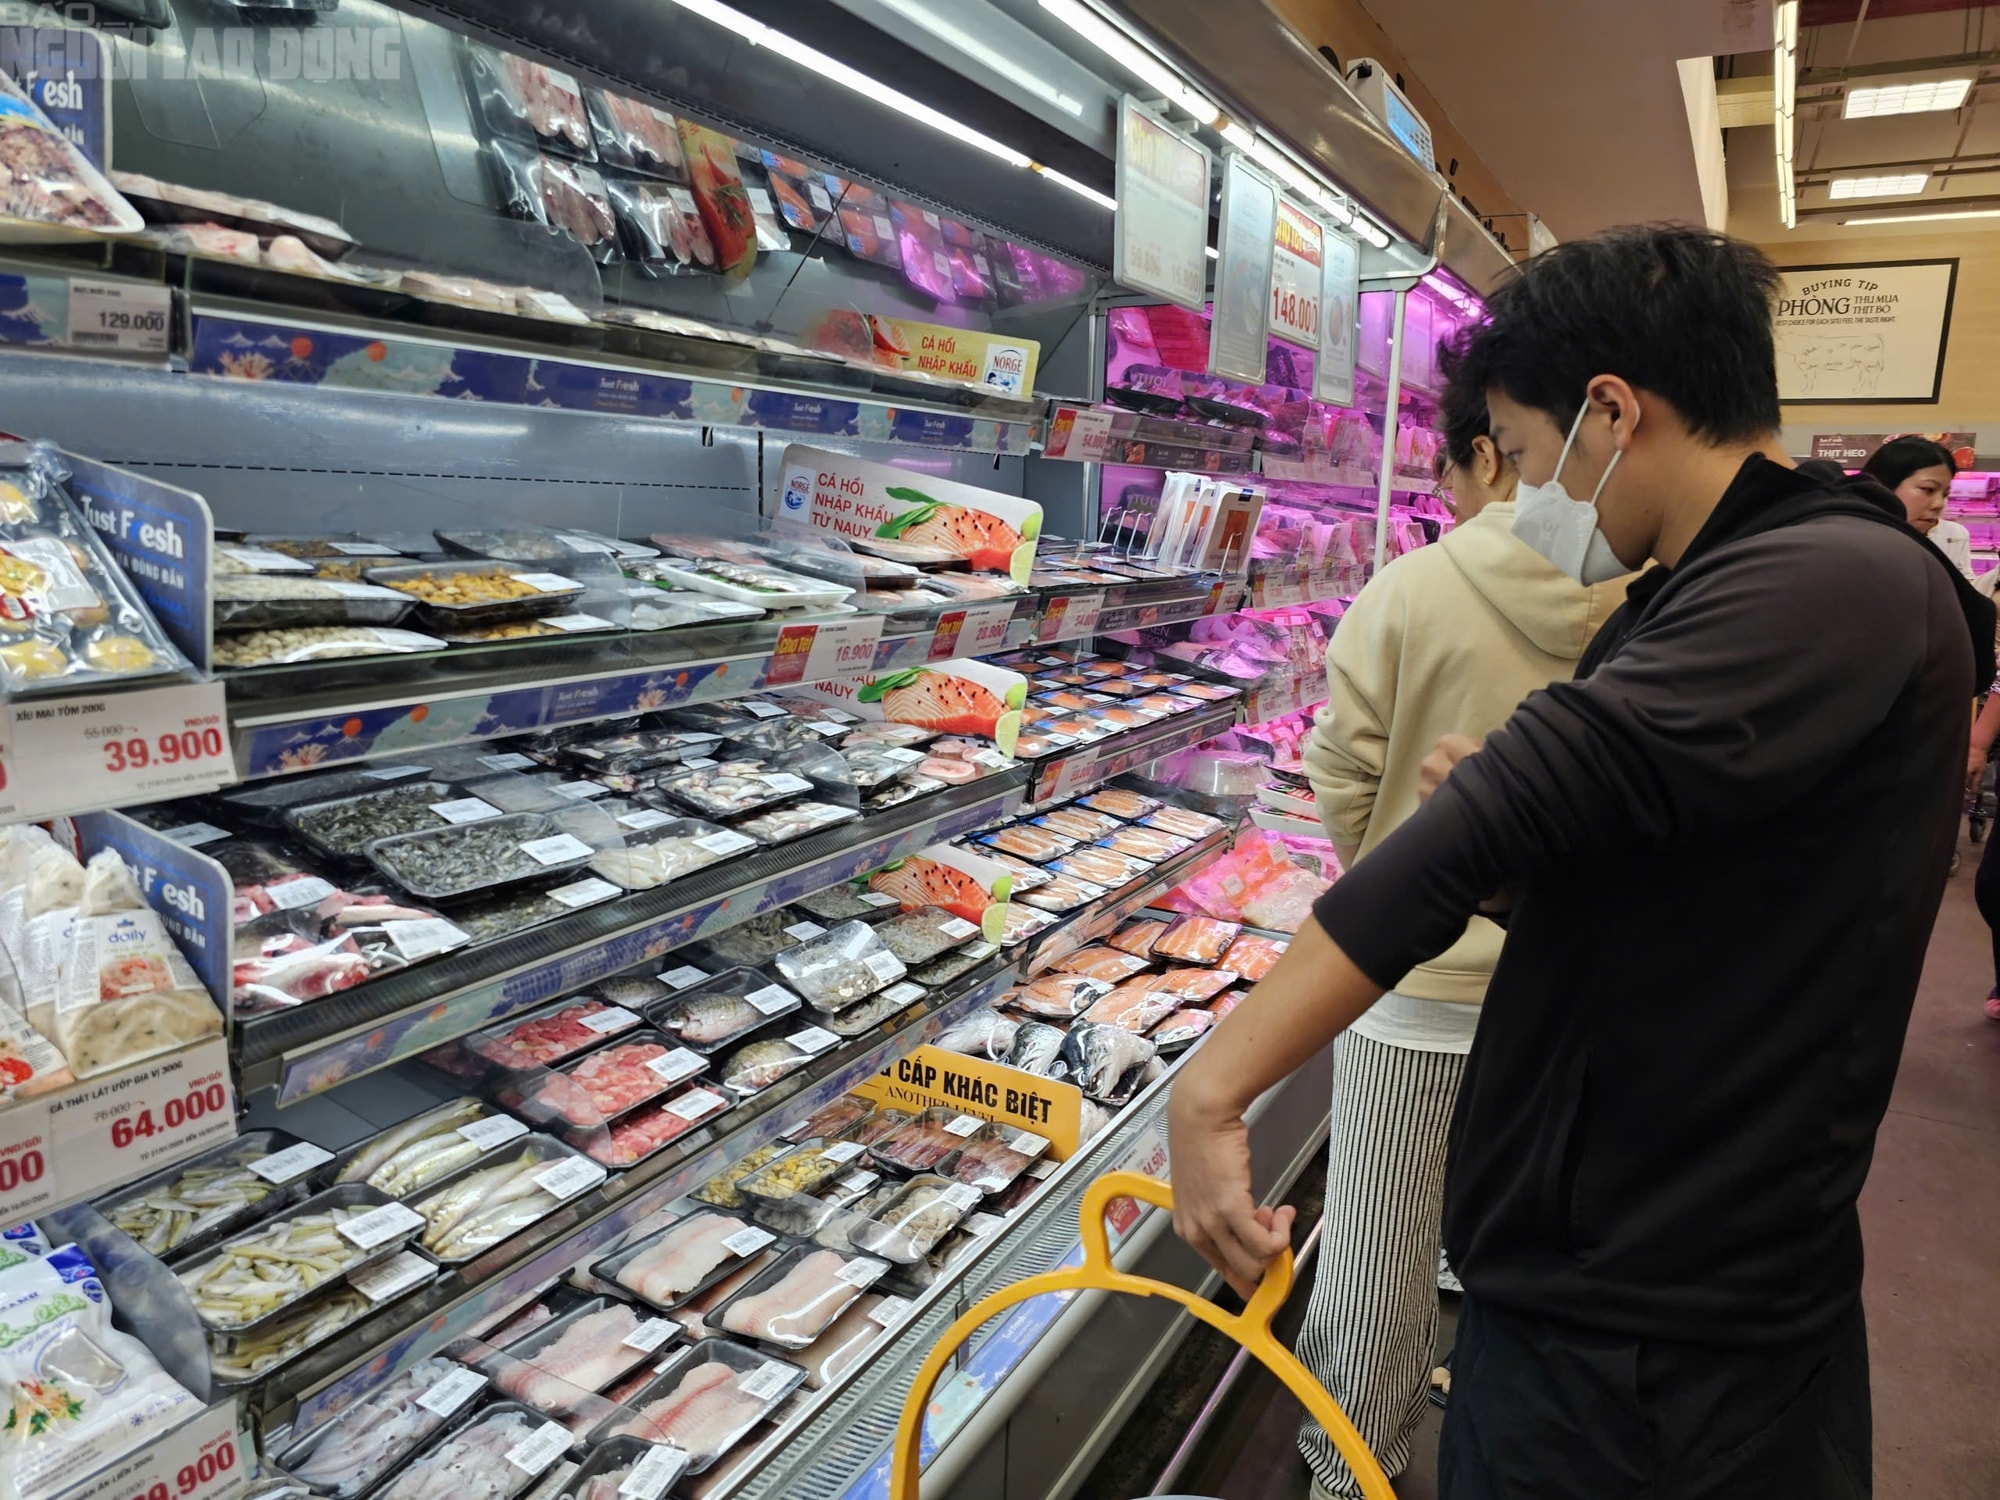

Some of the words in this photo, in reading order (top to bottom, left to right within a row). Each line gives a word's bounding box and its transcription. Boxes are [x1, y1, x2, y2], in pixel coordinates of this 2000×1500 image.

[1802, 279, 1852, 295] BUYING
[1858, 280, 1878, 291] TIP
[1777, 295, 1851, 316] PHÒNG
[1854, 296, 1874, 304] THU
[1875, 295, 1899, 304] MUA
[1273, 287, 1317, 335] 148.000
[1853, 306, 1875, 315] THỊT
[1876, 304, 1891, 314] BÒ
[100, 311, 164, 331] 129.000
[921, 335, 935, 349] CÁ
[918, 355, 946, 375] NHẬP
[949, 358, 977, 377] KHẨU
[992, 355, 1022, 372] NORGE
[1818, 450, 1841, 459] THỊT
[1843, 449, 1867, 457] HEO
[791, 480, 810, 494] NORGE
[817, 472, 836, 490] CÁ
[82, 496, 116, 534] Just
[814, 494, 851, 516] NHẬP
[854, 503, 894, 526] KHẨU
[812, 511, 832, 528] TỪ
[834, 519, 871, 538] NAUY
[836, 644, 873, 662] 16.900
[815, 681, 854, 699] NAUY
[58, 705, 79, 717] TÔM
[103, 728, 222, 772] 39.900
[108, 929, 147, 944] daily
[50, 1101, 64, 1114] CÁ
[134, 1073, 150, 1085] GIA
[162, 1061, 183, 1075] 300G
[188, 1071, 223, 1089] VND/GÓI
[899, 1056, 936, 1089] CẤP
[943, 1076, 998, 1108] KHÁC
[1006, 1091, 1052, 1125] BIỆT
[111, 1083, 225, 1148] 64.000
[0, 1136, 42, 1156] VND/GÓI
